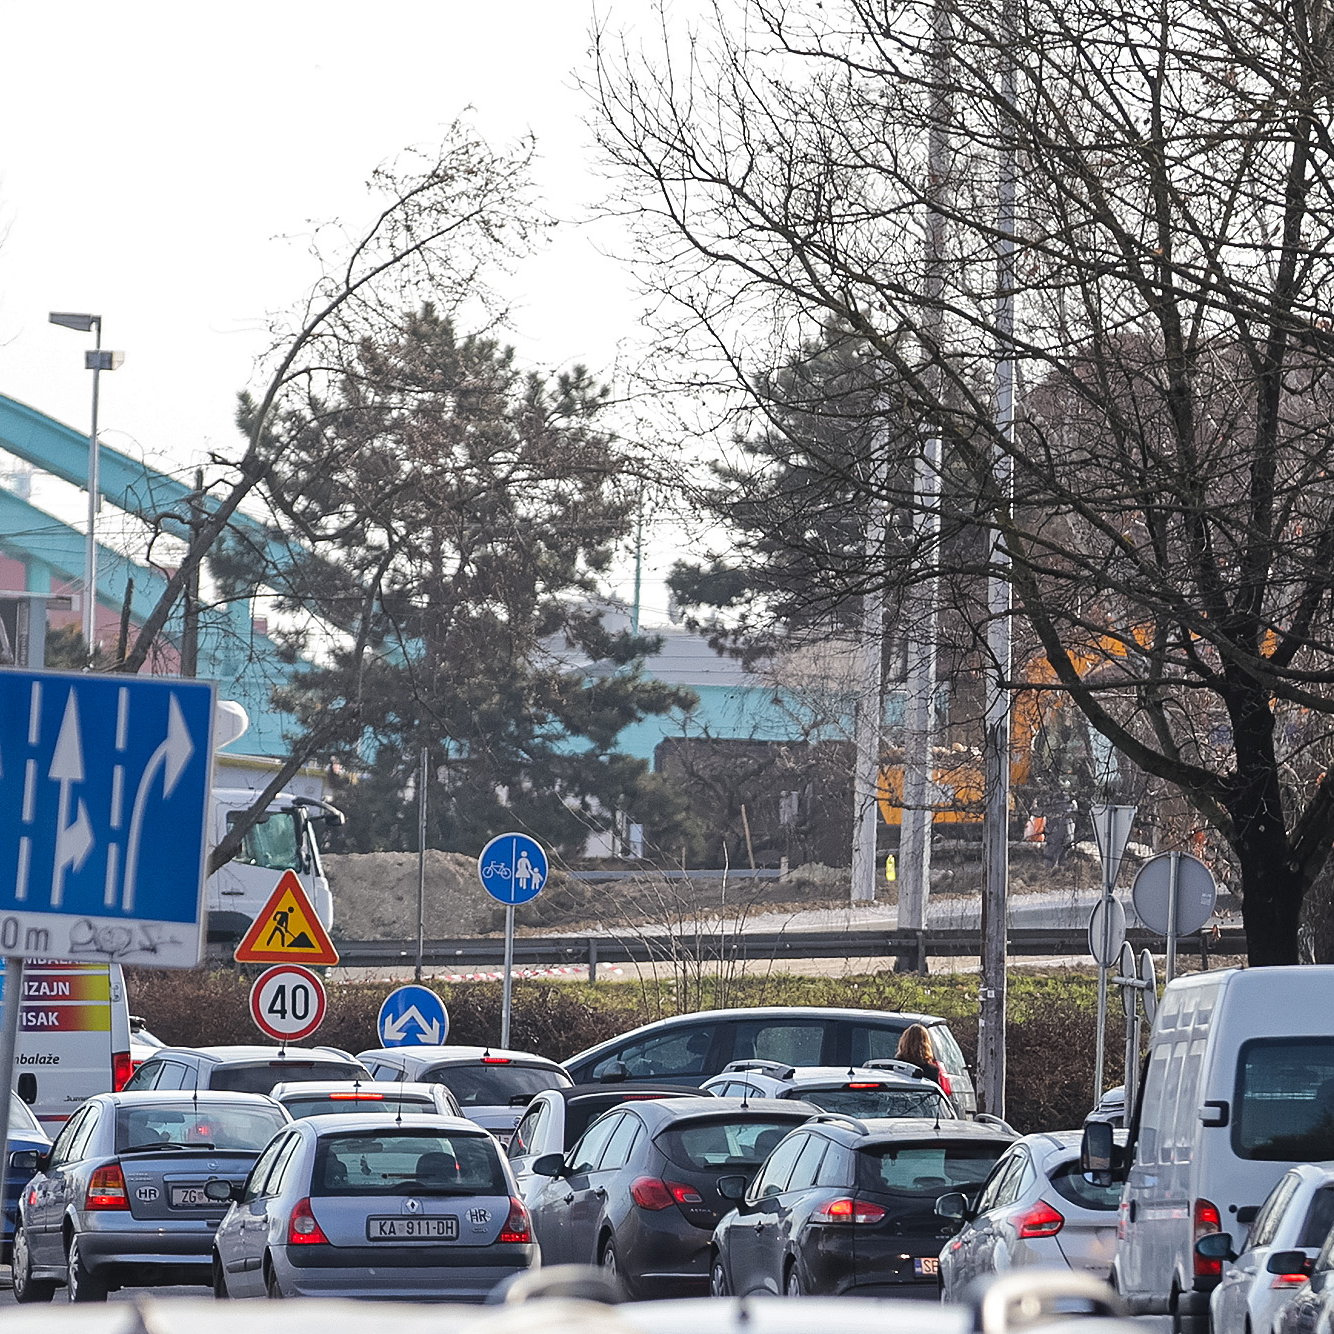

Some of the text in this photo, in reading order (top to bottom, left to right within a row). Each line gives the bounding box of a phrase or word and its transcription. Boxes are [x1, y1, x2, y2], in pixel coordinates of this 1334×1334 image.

[25, 927, 49, 951] m
[23, 981, 70, 996] IZAJN
[268, 984, 309, 1020] 40
[20, 1011, 60, 1026] ISAK
[138, 1188, 158, 1199] HR
[181, 1190, 197, 1203] ZG
[469, 1208, 488, 1224] HR
[378, 1221, 454, 1235] KA 911-DH
